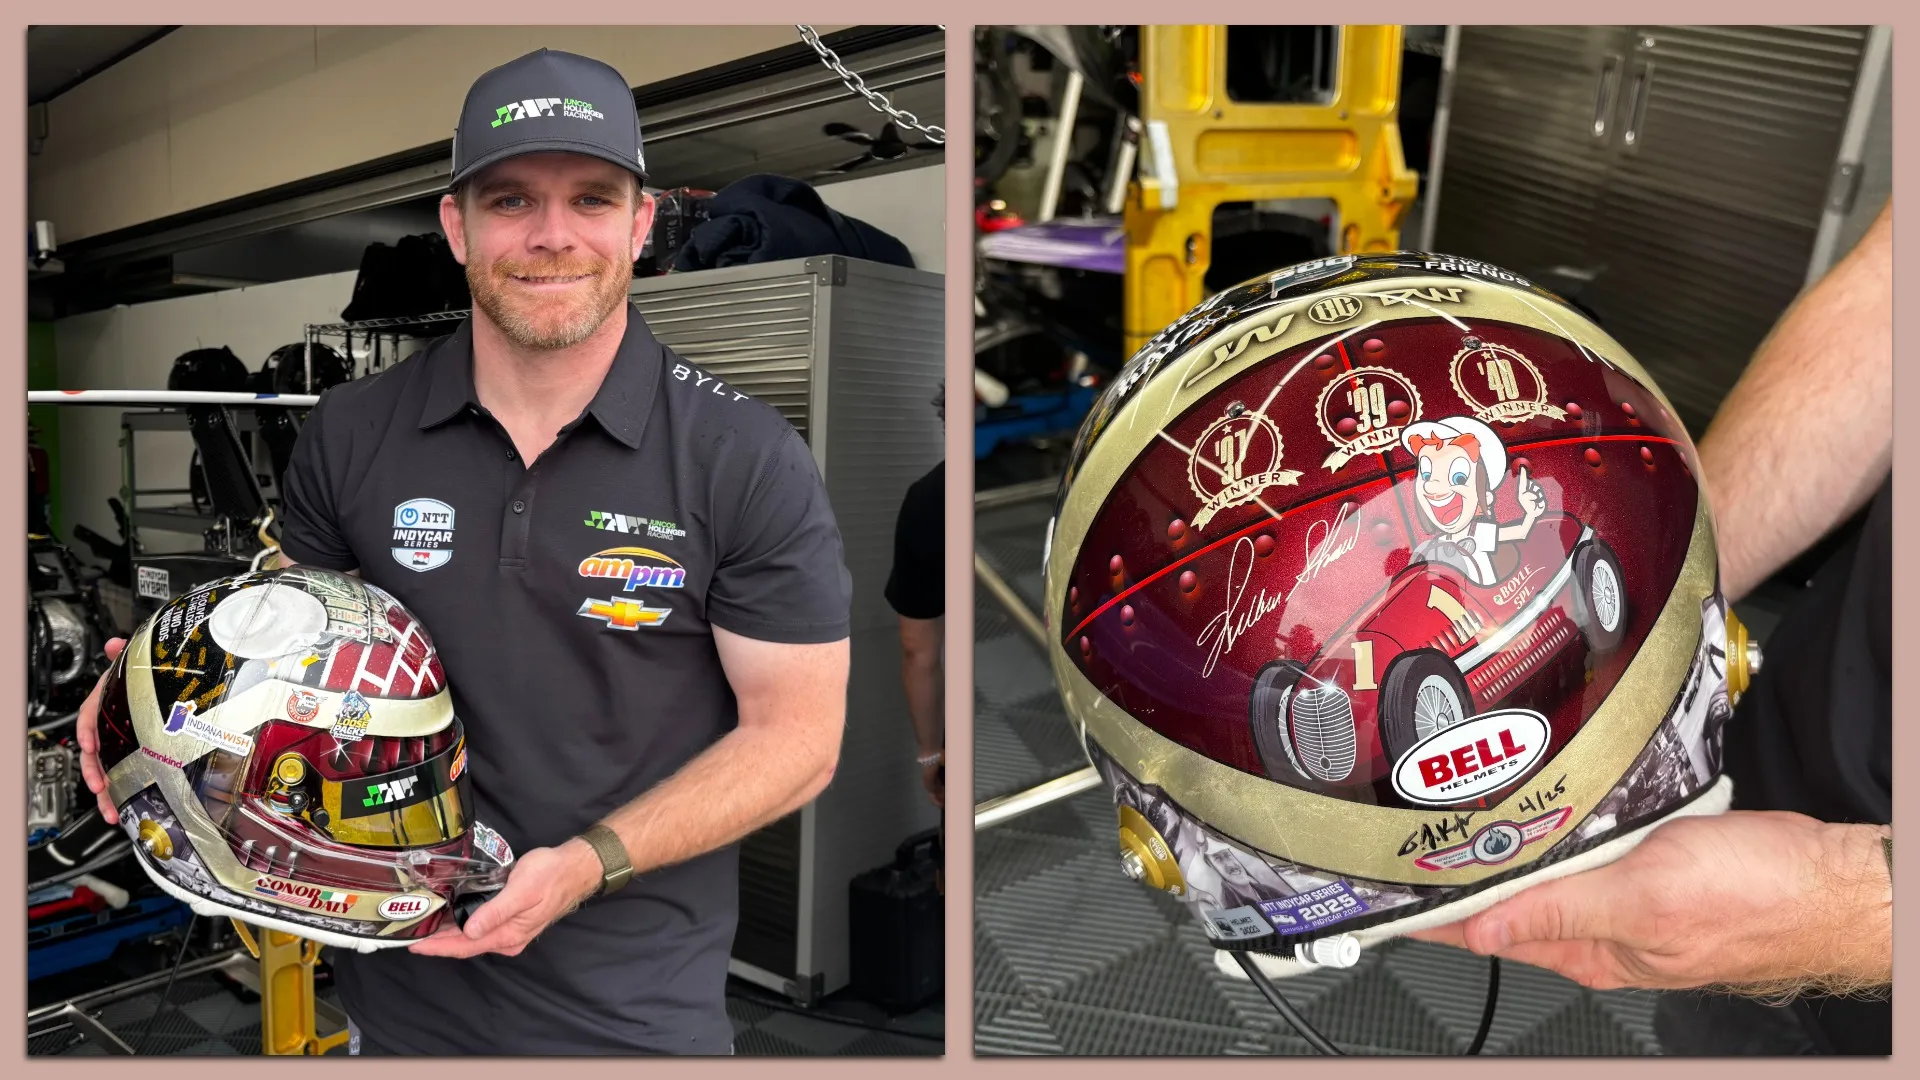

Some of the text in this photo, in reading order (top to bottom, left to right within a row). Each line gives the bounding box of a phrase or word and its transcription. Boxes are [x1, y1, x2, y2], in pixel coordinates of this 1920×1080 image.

[563, 104, 604, 120] HOLLINGER
[564, 98, 592, 110] JUNCOS
[563, 110, 593, 122] RACING
[1425, 261, 1531, 287] FRIENDS
[1445, 257, 1499, 272] TWO
[672, 363, 749, 401] BYLT
[1476, 359, 1520, 401] '40
[1346, 382, 1388, 433] '39
[1480, 402, 1550, 421] WINNER
[1341, 427, 1402, 456] WINN
[1207, 473, 1281, 511] WINNER
[421, 512, 449, 523] NTT
[649, 519, 677, 529] JUNCOS
[392, 529, 453, 543] INDYCAR
[646, 531, 674, 541] RACING
[647, 524, 686, 538] HOLLINGER
[404, 540, 438, 548] SERIES
[578, 557, 686, 592] ampm
[1499, 563, 1533, 599] BOYLE
[140, 579, 168, 598] HYBRID
[158, 608, 174, 642] FRIENDS
[170, 609, 184, 628] TWO
[1426, 584, 1484, 646] 1
[1350, 639, 1378, 691] 1
[333, 725, 366, 737] PACKS
[337, 717, 369, 729] LOOSE
[141, 746, 183, 769] mannkind
[1418, 728, 1527, 788] BELL
[1440, 758, 1519, 792] HELMETS
[1518, 773, 1567, 813] 4/25
[257, 877, 321, 900] CONOR
[1260, 882, 1345, 913] NTT INDYCAR SERIES
[308, 896, 353, 914] DALY
[387, 901, 422, 912] BELL
[1298, 893, 1358, 921] 2025
[1312, 912, 1342, 927] INDYCAR
[1342, 904, 1363, 917] 2025
